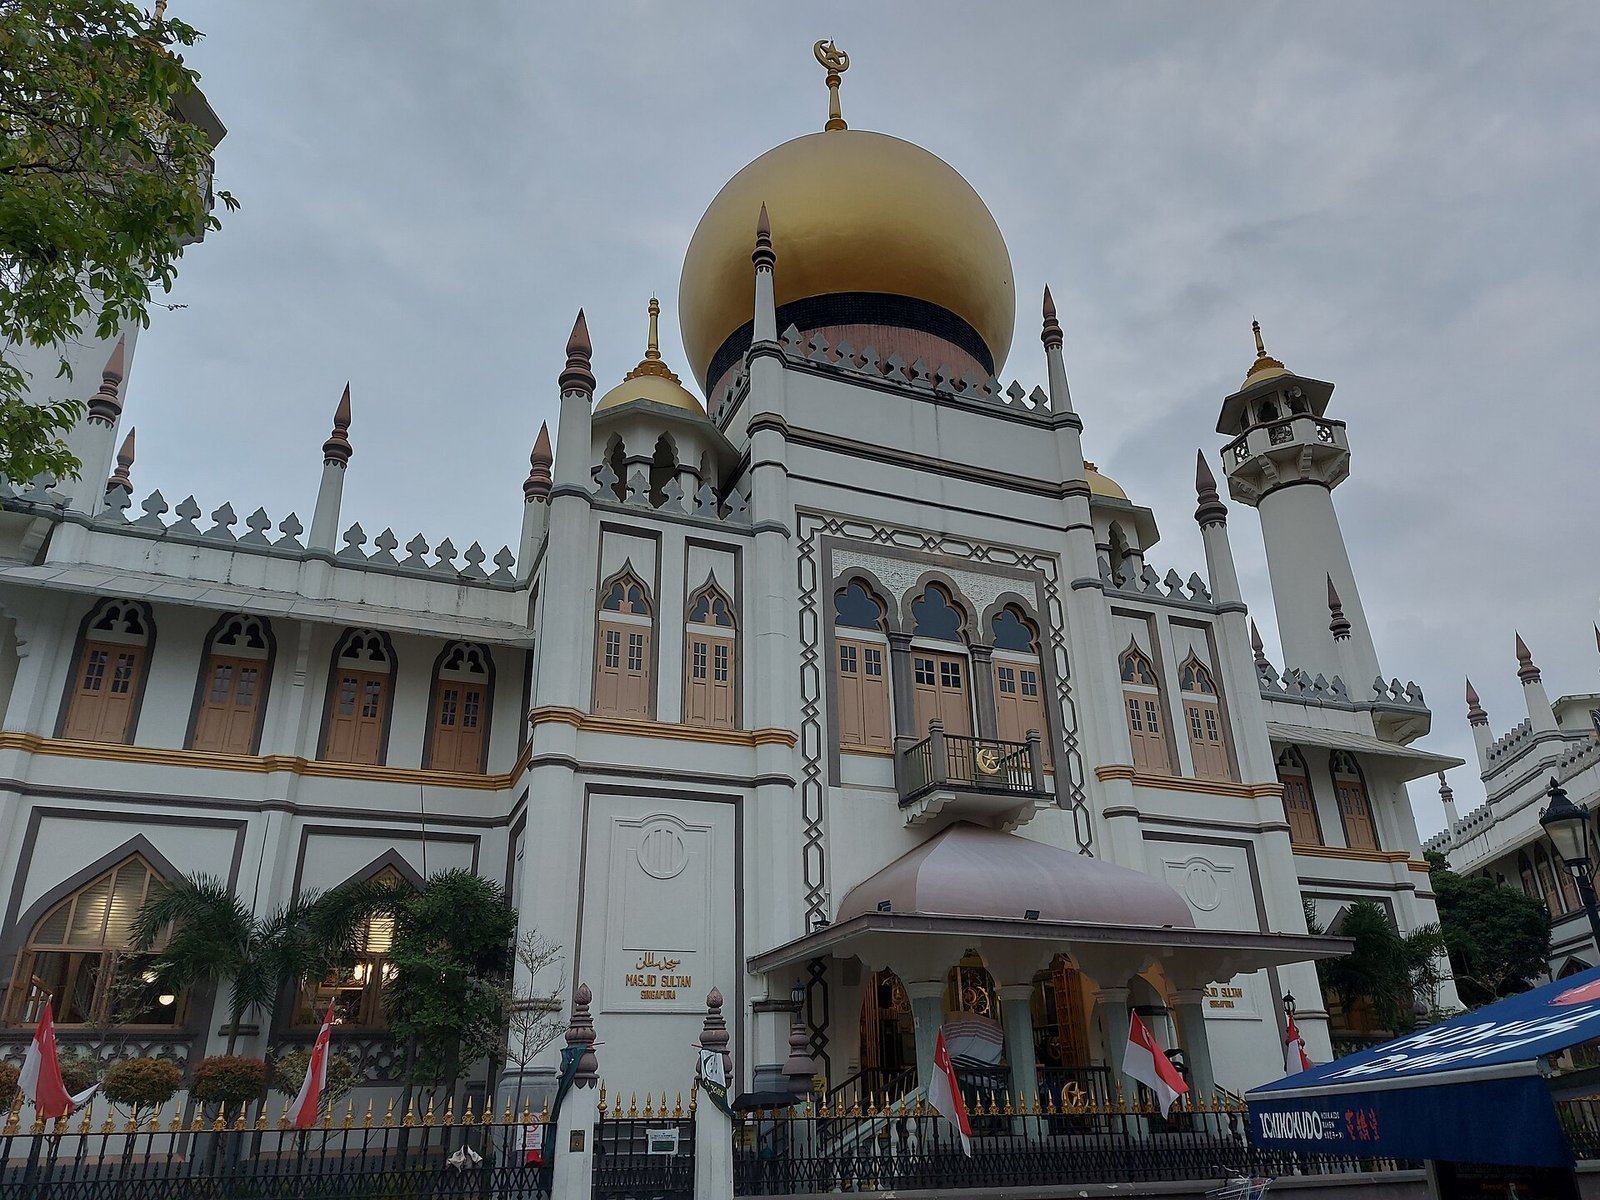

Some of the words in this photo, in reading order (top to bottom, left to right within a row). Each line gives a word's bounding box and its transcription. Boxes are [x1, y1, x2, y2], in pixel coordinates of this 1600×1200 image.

[625, 974, 656, 987] MASJID
[661, 975, 691, 988] SULTAN
[640, 990, 676, 1000] SINGAPURA
[1221, 987, 1243, 998] SULTAN
[1259, 1110, 1323, 1140] ICHIKOKUDO
